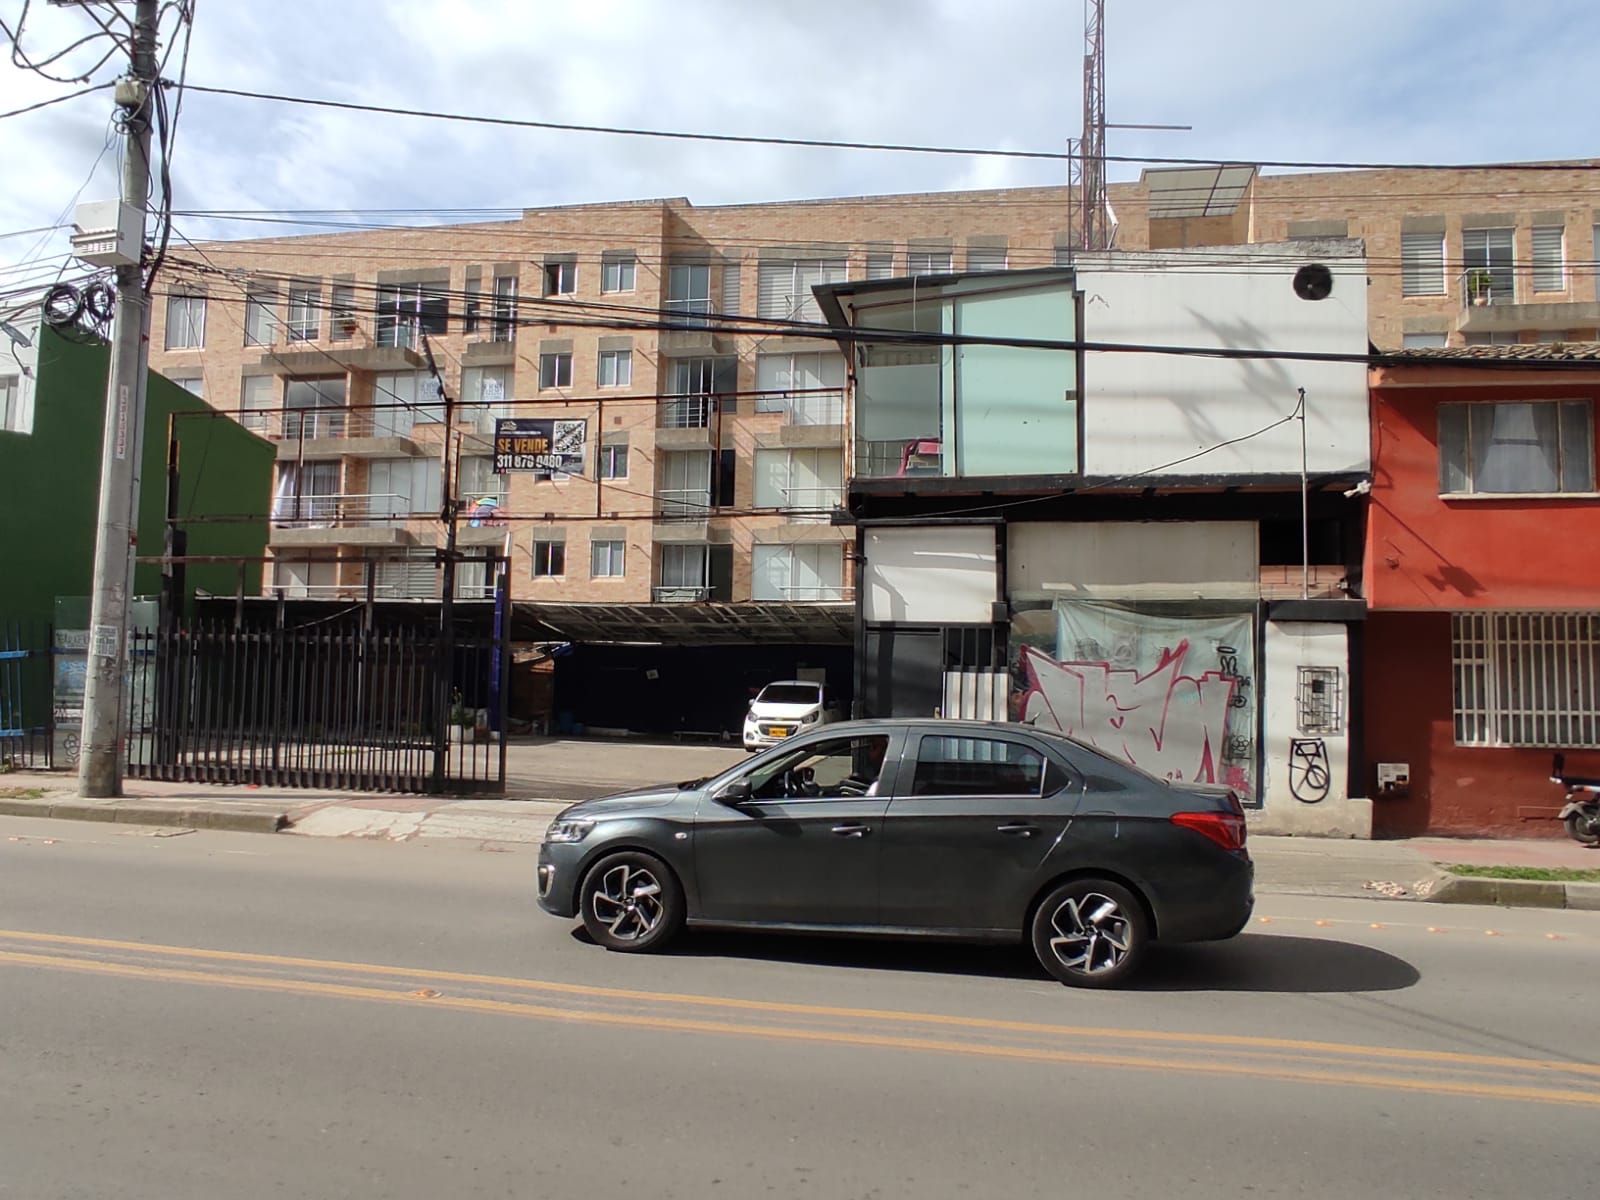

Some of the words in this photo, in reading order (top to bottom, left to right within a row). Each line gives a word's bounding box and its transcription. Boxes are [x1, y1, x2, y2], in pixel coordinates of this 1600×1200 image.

[498, 438, 512, 454] SE
[514, 438, 548, 454] VENDE
[497, 455, 512, 468] 311
